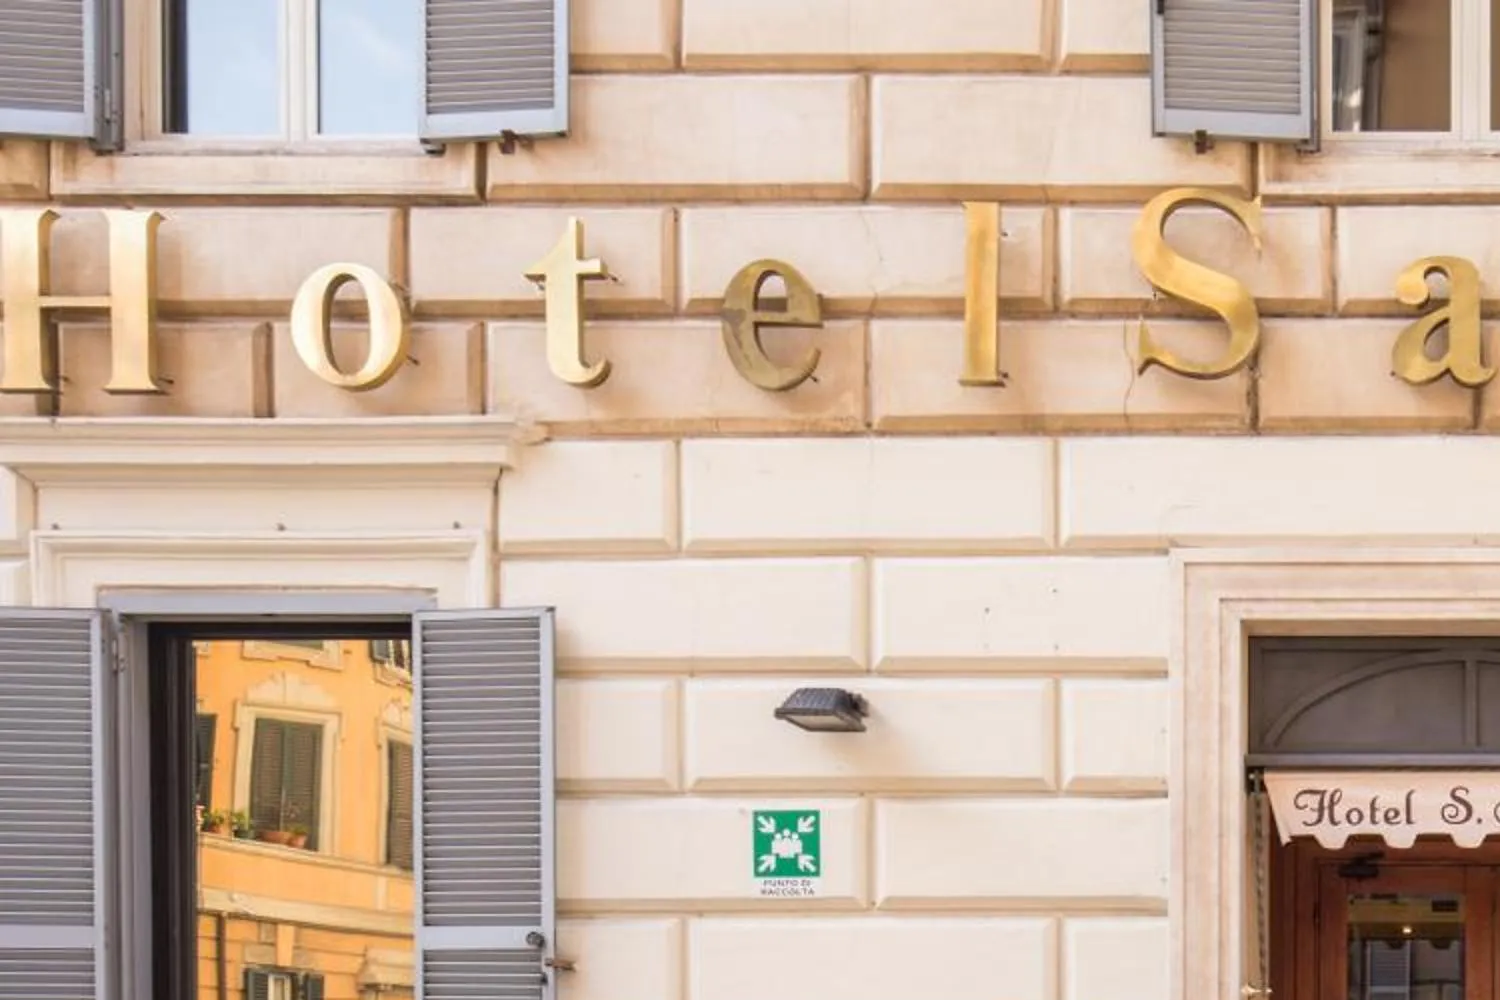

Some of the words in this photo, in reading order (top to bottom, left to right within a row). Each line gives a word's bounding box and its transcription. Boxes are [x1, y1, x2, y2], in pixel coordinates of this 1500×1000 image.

[0, 199, 1007, 395] Hotel
[1294, 787, 1416, 827] Hotel
[1440, 785, 1483, 825] S.
